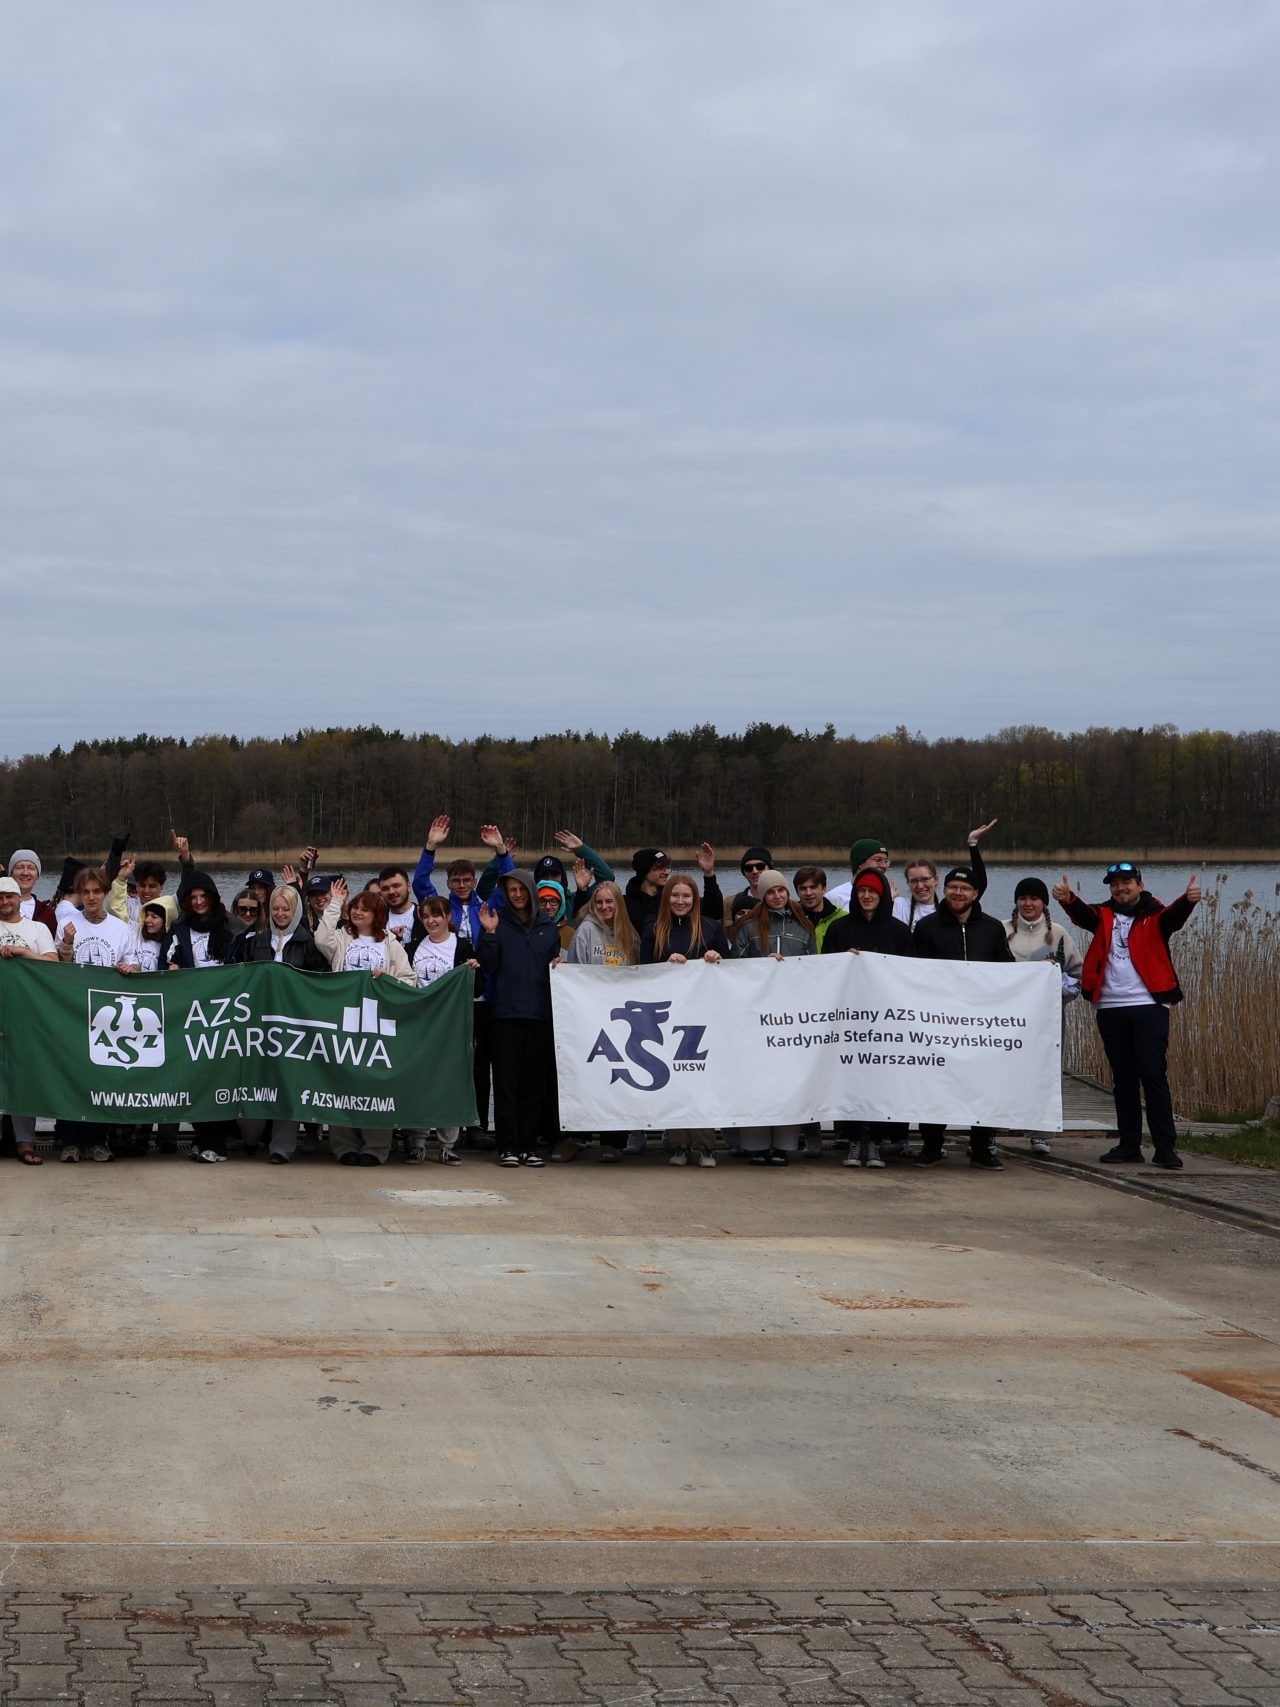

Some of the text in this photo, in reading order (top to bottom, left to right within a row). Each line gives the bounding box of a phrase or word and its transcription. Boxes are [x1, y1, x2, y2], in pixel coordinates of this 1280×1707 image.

[183, 993, 250, 1030] AZS
[760, 1008, 1026, 1028] Klub Uczelniany AZS Uniwersytetu
[184, 1027, 392, 1068] WARSZAWA
[766, 1029, 1023, 1052] Kardynała Stefana Wyszyńskiego
[672, 1062, 706, 1072] UKSW
[840, 1053, 946, 1067] w Warszawie
[90, 1091, 192, 1108] WWW.AZS.WAW.PL
[231, 1087, 278, 1103] AZS_WAW
[311, 1091, 396, 1112] AZSWARSZAWA
